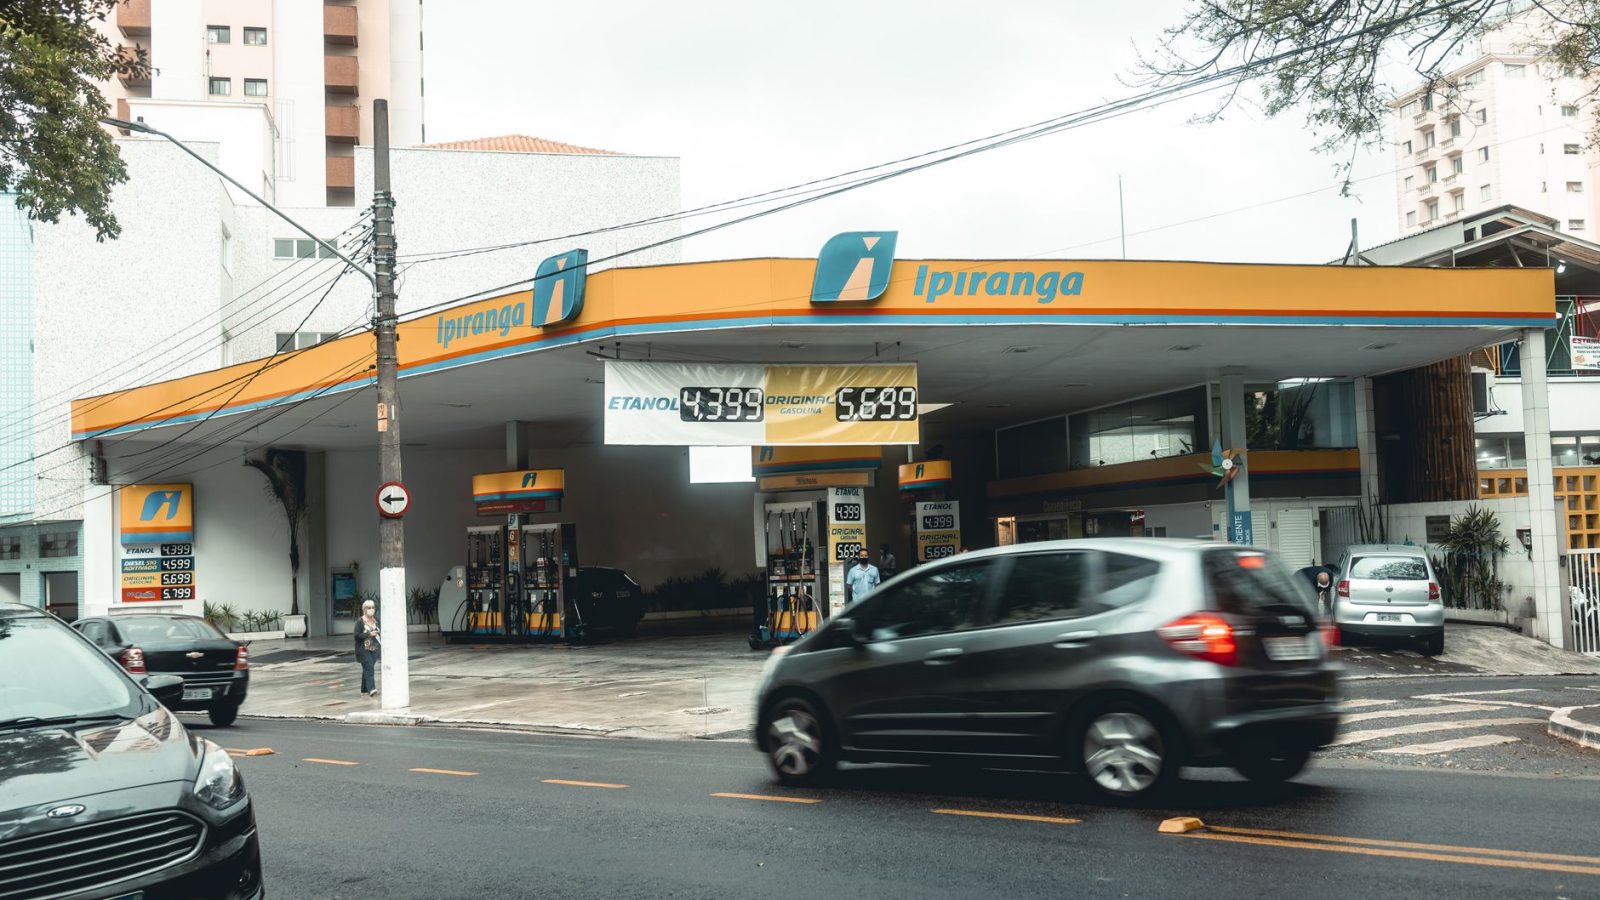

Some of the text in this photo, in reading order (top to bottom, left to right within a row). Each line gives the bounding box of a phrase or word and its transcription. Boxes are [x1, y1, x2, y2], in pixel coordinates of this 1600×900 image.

[913, 264, 1084, 304] Ipiranga
[437, 302, 525, 349] Ipiranga
[607, 396, 680, 411] ETANOL
[765, 395, 835, 405] ORIGINAL
[780, 407, 822, 415] GASOLINA
[835, 487, 860, 496] ETANOL
[923, 503, 953, 511] ETANOL
[831, 528, 865, 536] ORIGINAL
[126, 547, 155, 555] ETANOL
